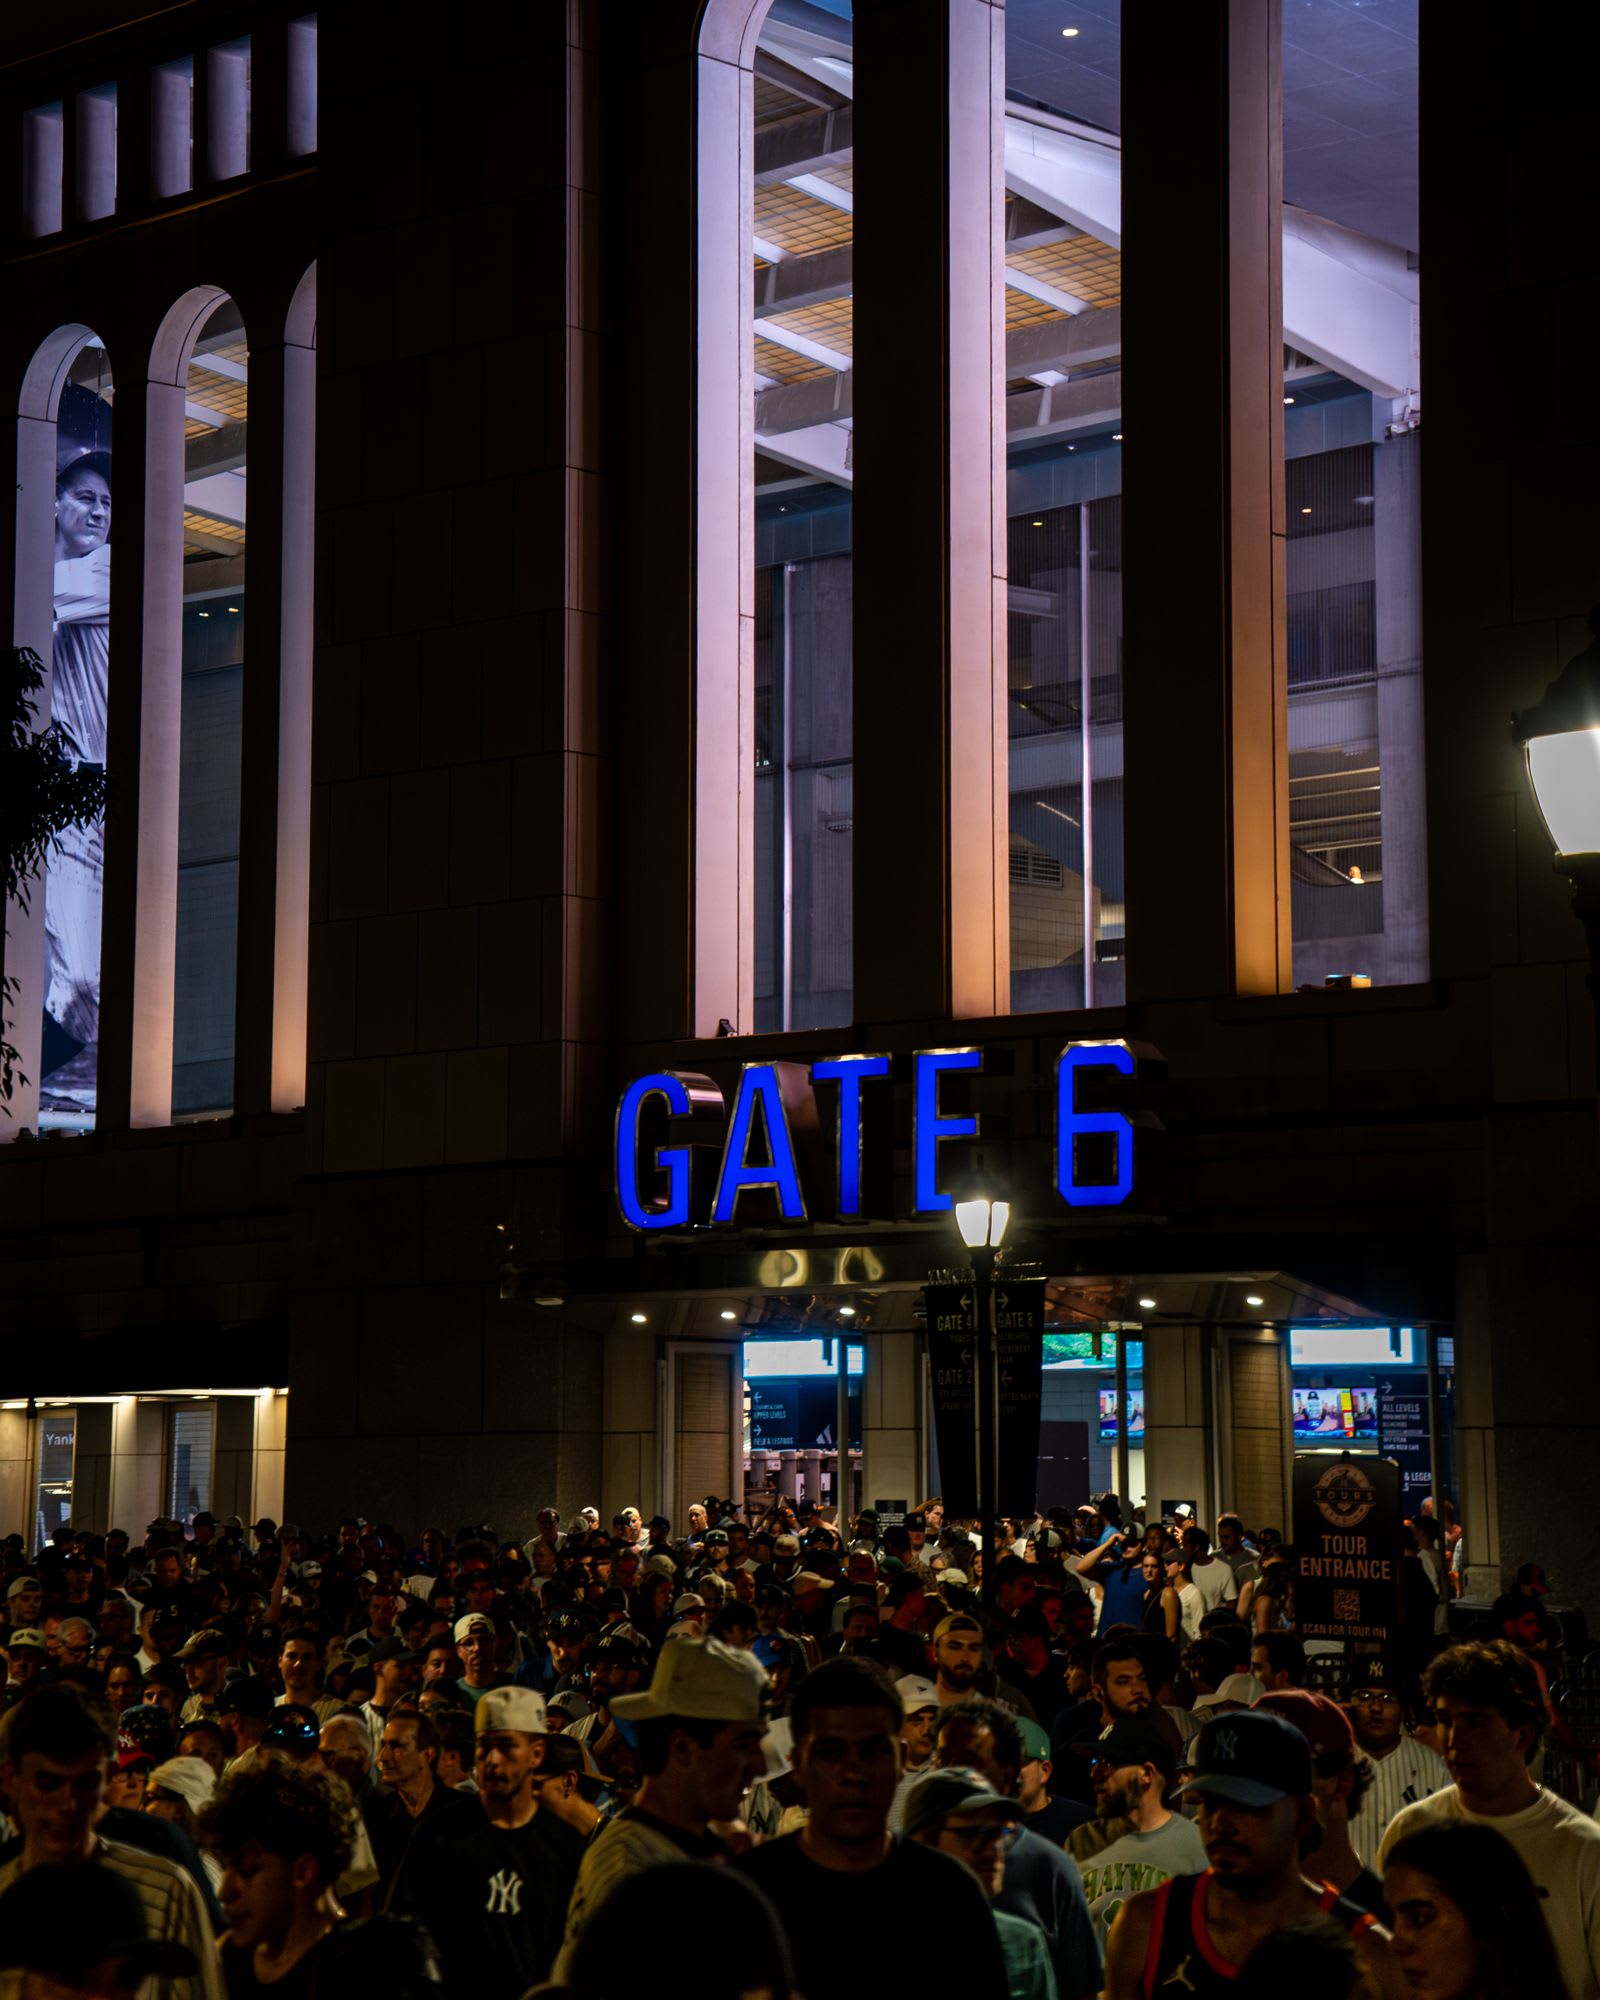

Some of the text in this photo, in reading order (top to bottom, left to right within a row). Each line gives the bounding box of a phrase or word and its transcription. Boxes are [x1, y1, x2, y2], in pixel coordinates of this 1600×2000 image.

[615, 1038, 1138, 1230] GATE 6
[936, 1314, 972, 1331] GATE 4
[997, 1312, 1024, 1328] GATE
[937, 1368, 973, 1385] GATE 2
[770, 1410, 787, 1419] LEVELS
[1382, 1403, 1420, 1413] ALL LEVELS
[1314, 1490, 1374, 1502] TOURS
[1320, 1534, 1368, 1556] TOUR
[1299, 1557, 1392, 1581] ENTRANCE
[1302, 1623, 1326, 1634] SCAN
[1328, 1624, 1345, 1636] FOR
[1348, 1625, 1371, 1638] TOUR
[1368, 1659, 1385, 1677] NY
[1212, 1727, 1240, 1760] NY
[485, 1868, 525, 1916] NY
